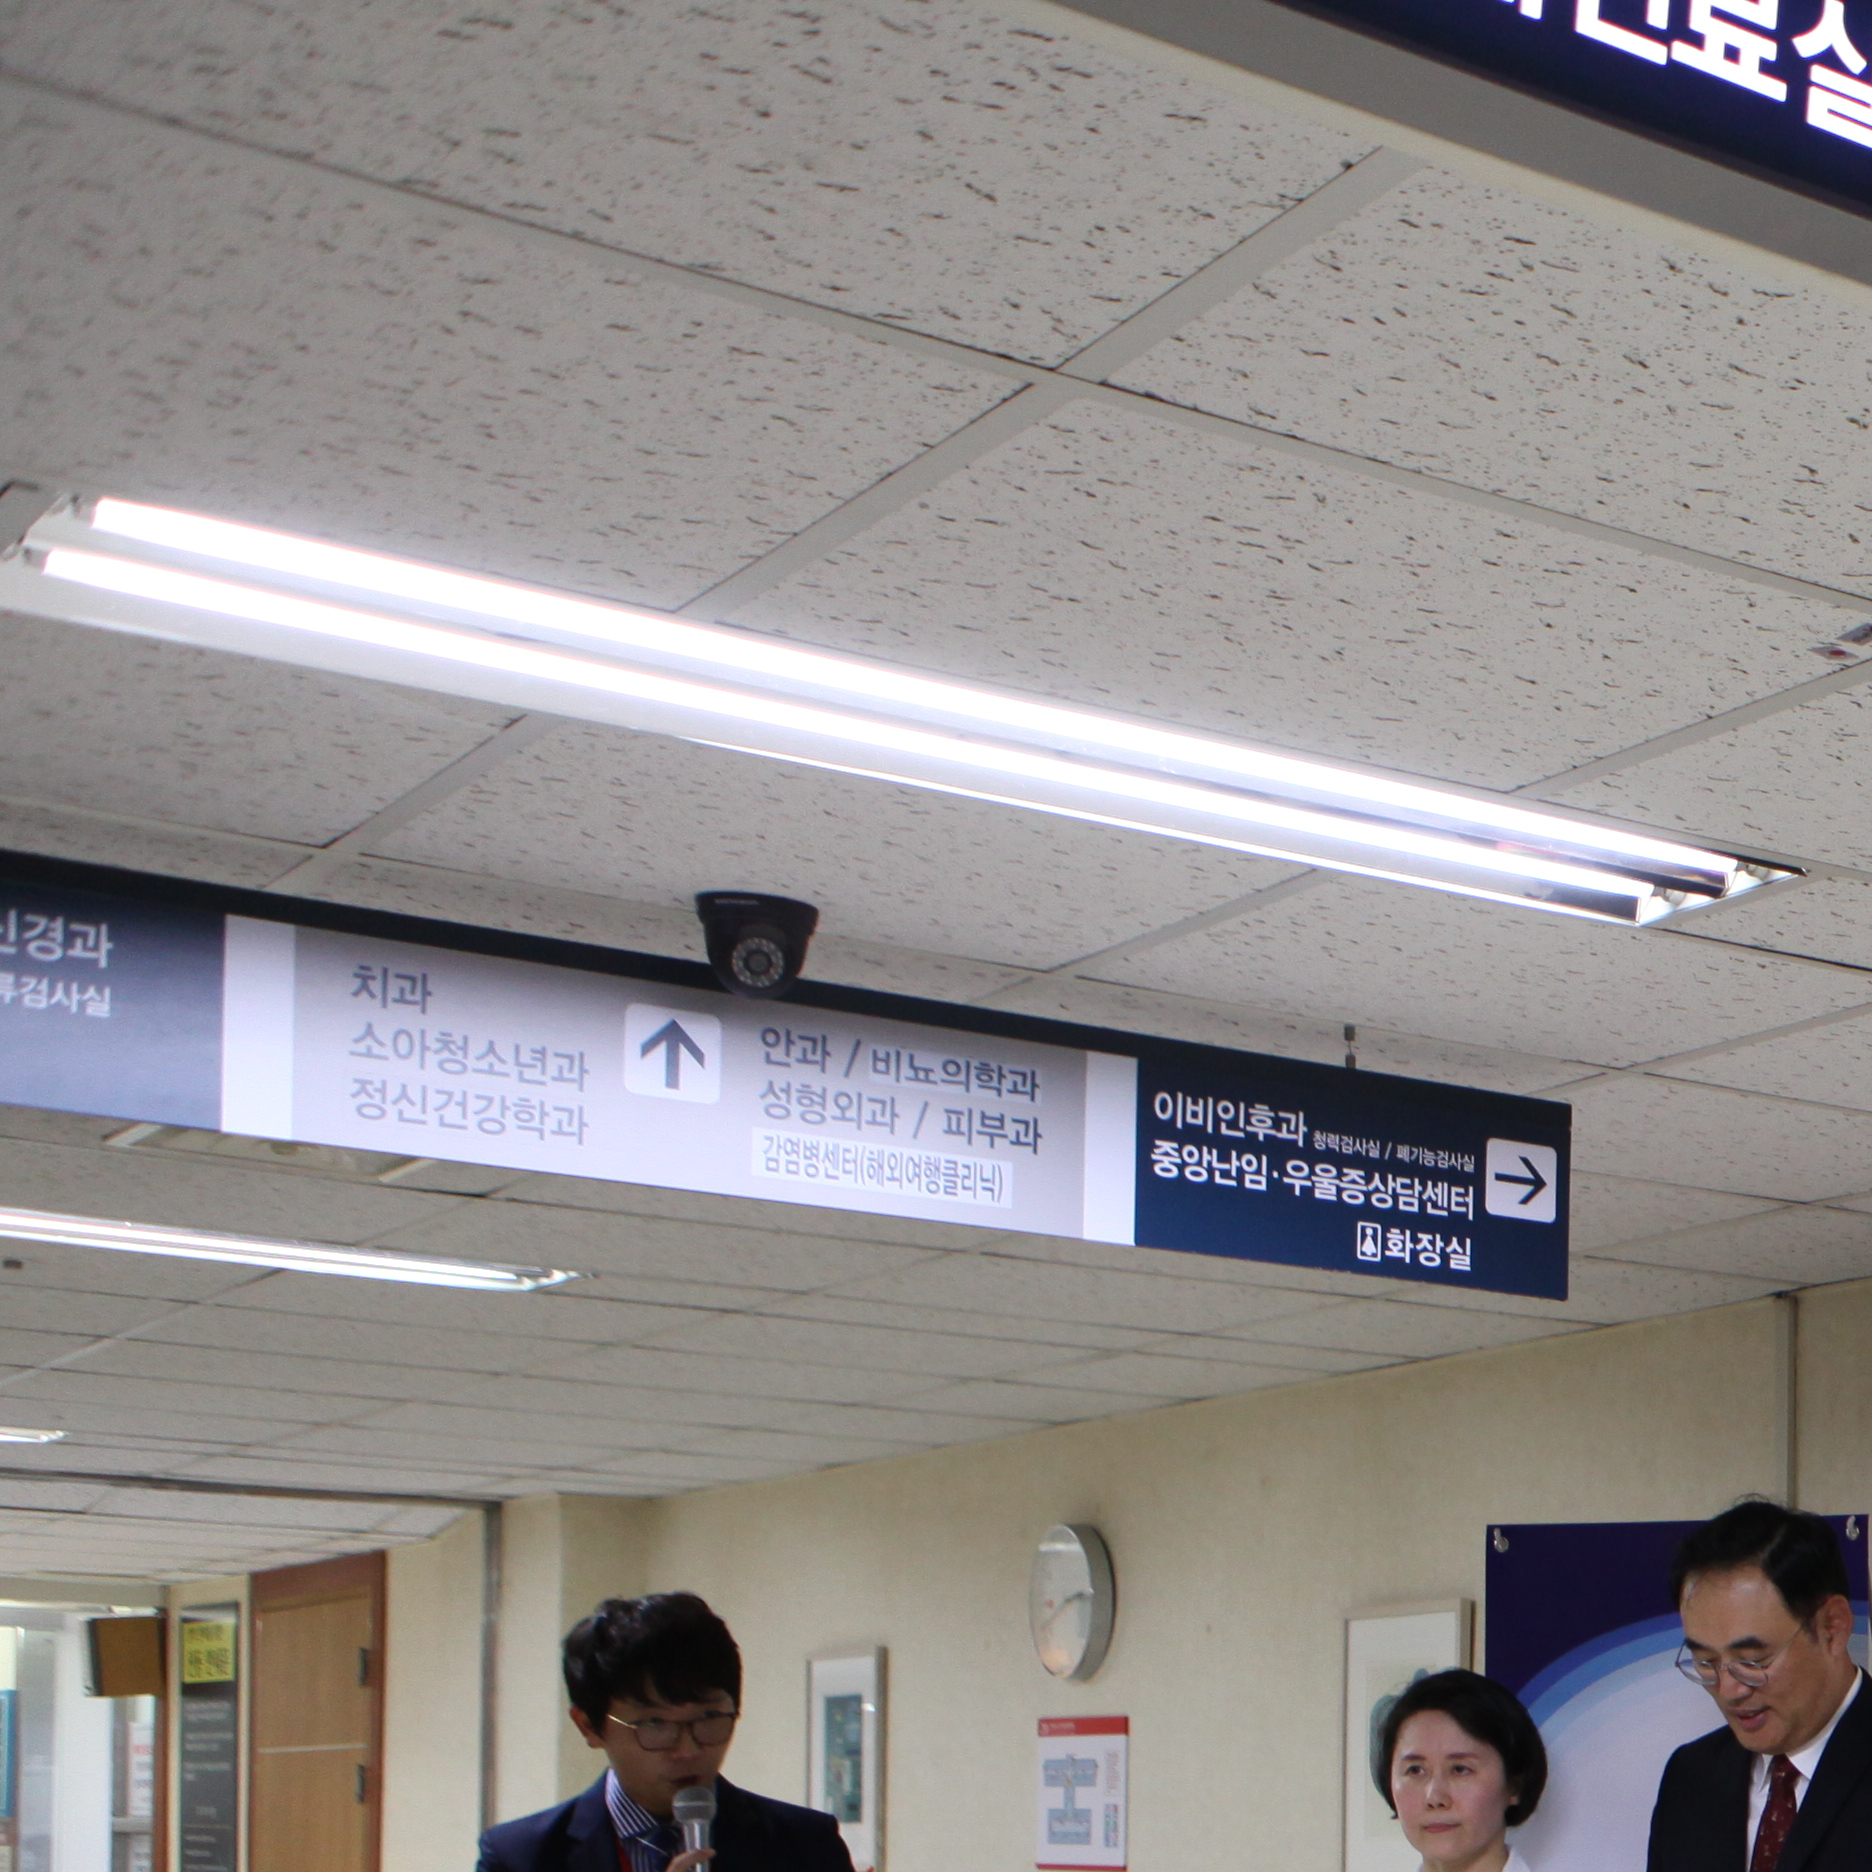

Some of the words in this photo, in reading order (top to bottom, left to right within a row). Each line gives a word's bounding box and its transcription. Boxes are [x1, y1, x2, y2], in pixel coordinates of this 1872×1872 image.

[350, 963, 433, 1015] 치과
[346, 1021, 590, 1093] 소아청소년과
[760, 1026, 831, 1074] 안과
[870, 1047, 1041, 1102] 비뇨의학과
[347, 1075, 590, 1147] 정신건강학과
[759, 1079, 900, 1135] 성형외과
[942, 1106, 1043, 1155] 피부과
[1154, 1091, 1307, 1147] 이비인후과
[1313, 1130, 1381, 1159] 청력검사실
[1396, 1143, 1475, 1173] 폐기능검사실
[762, 1134, 1005, 1203] 감염병센터(해외여행클리닉)
[1151, 1139, 1475, 1221] 중앙난임·우울증상담센터
[1384, 1228, 1473, 1272] 화장실
